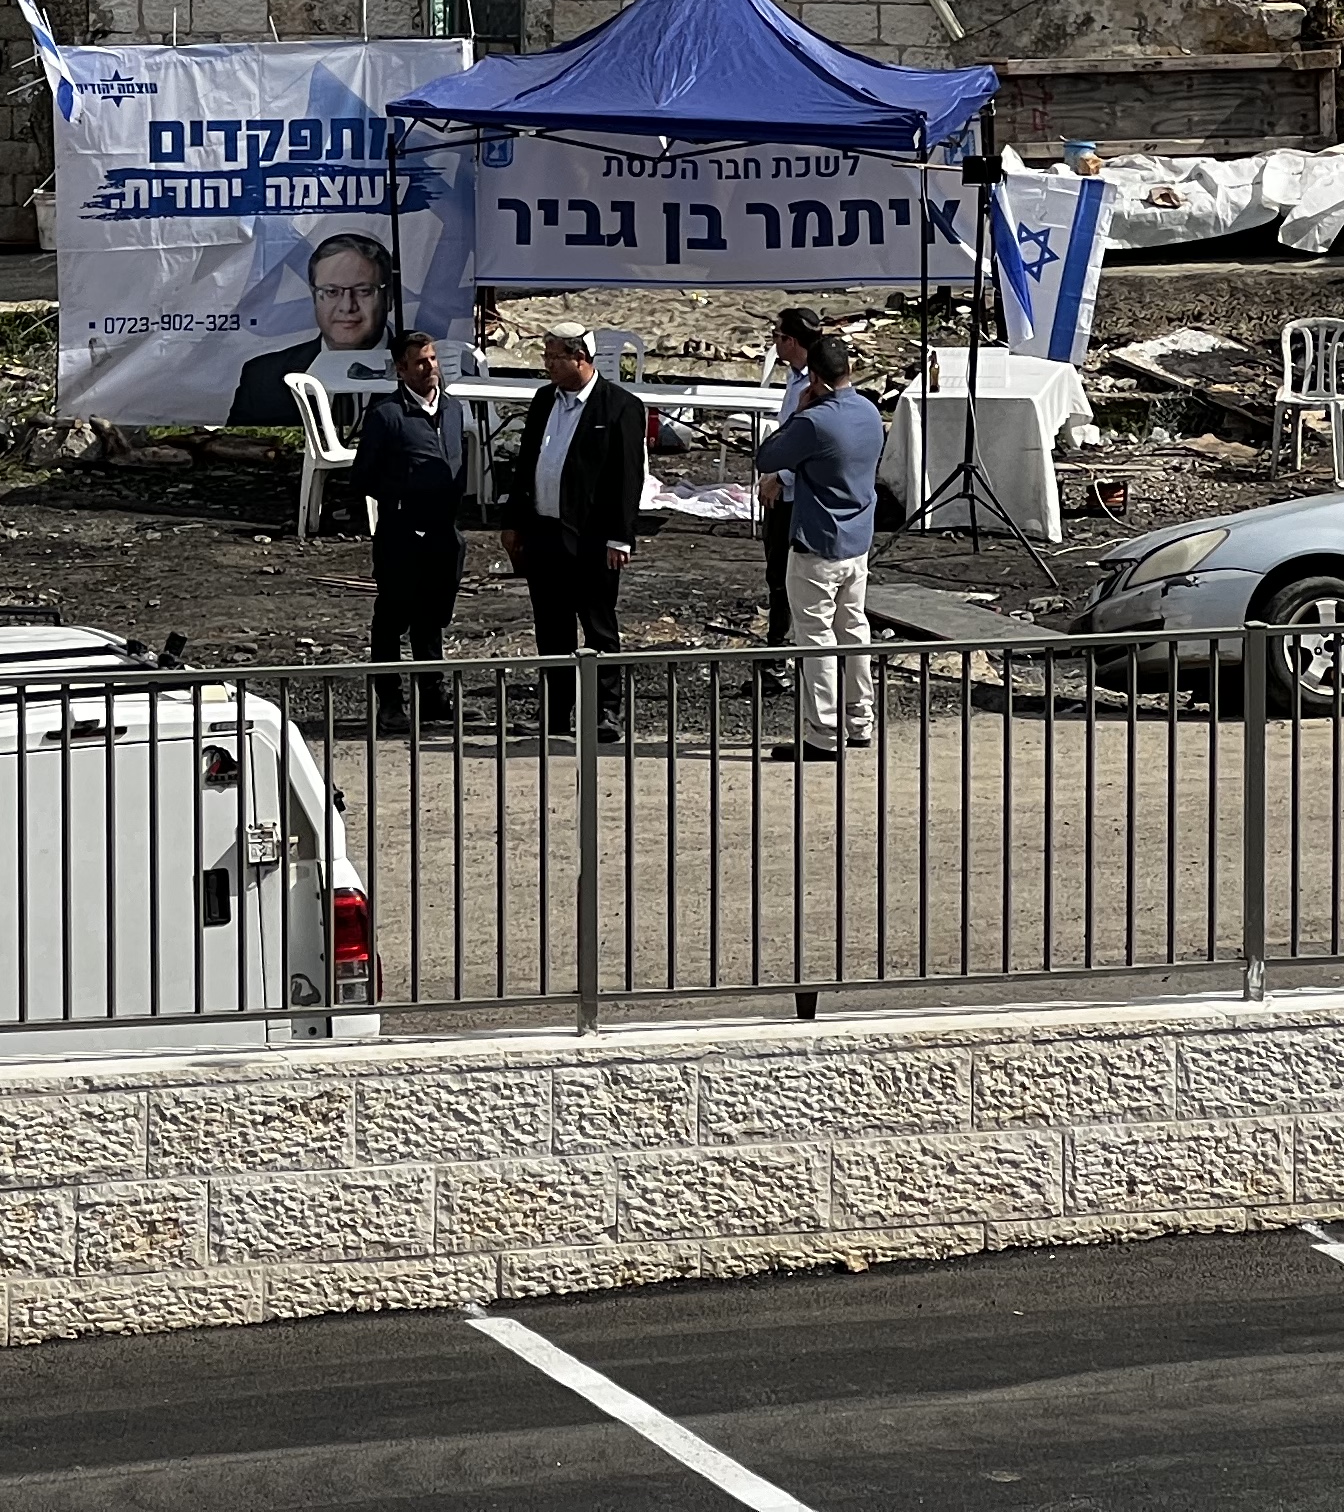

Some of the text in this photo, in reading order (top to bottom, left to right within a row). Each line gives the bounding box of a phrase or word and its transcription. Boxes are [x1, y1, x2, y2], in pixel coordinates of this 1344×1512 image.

[117, 82, 158, 94] עוצמה
[149, 118, 405, 167] מתפקדים
[603, 148, 860, 180] לשכת חבר הכנסת
[497, 197, 961, 265] איתמר בן גביר
[104, 314, 241, 334] 0723-902-323
